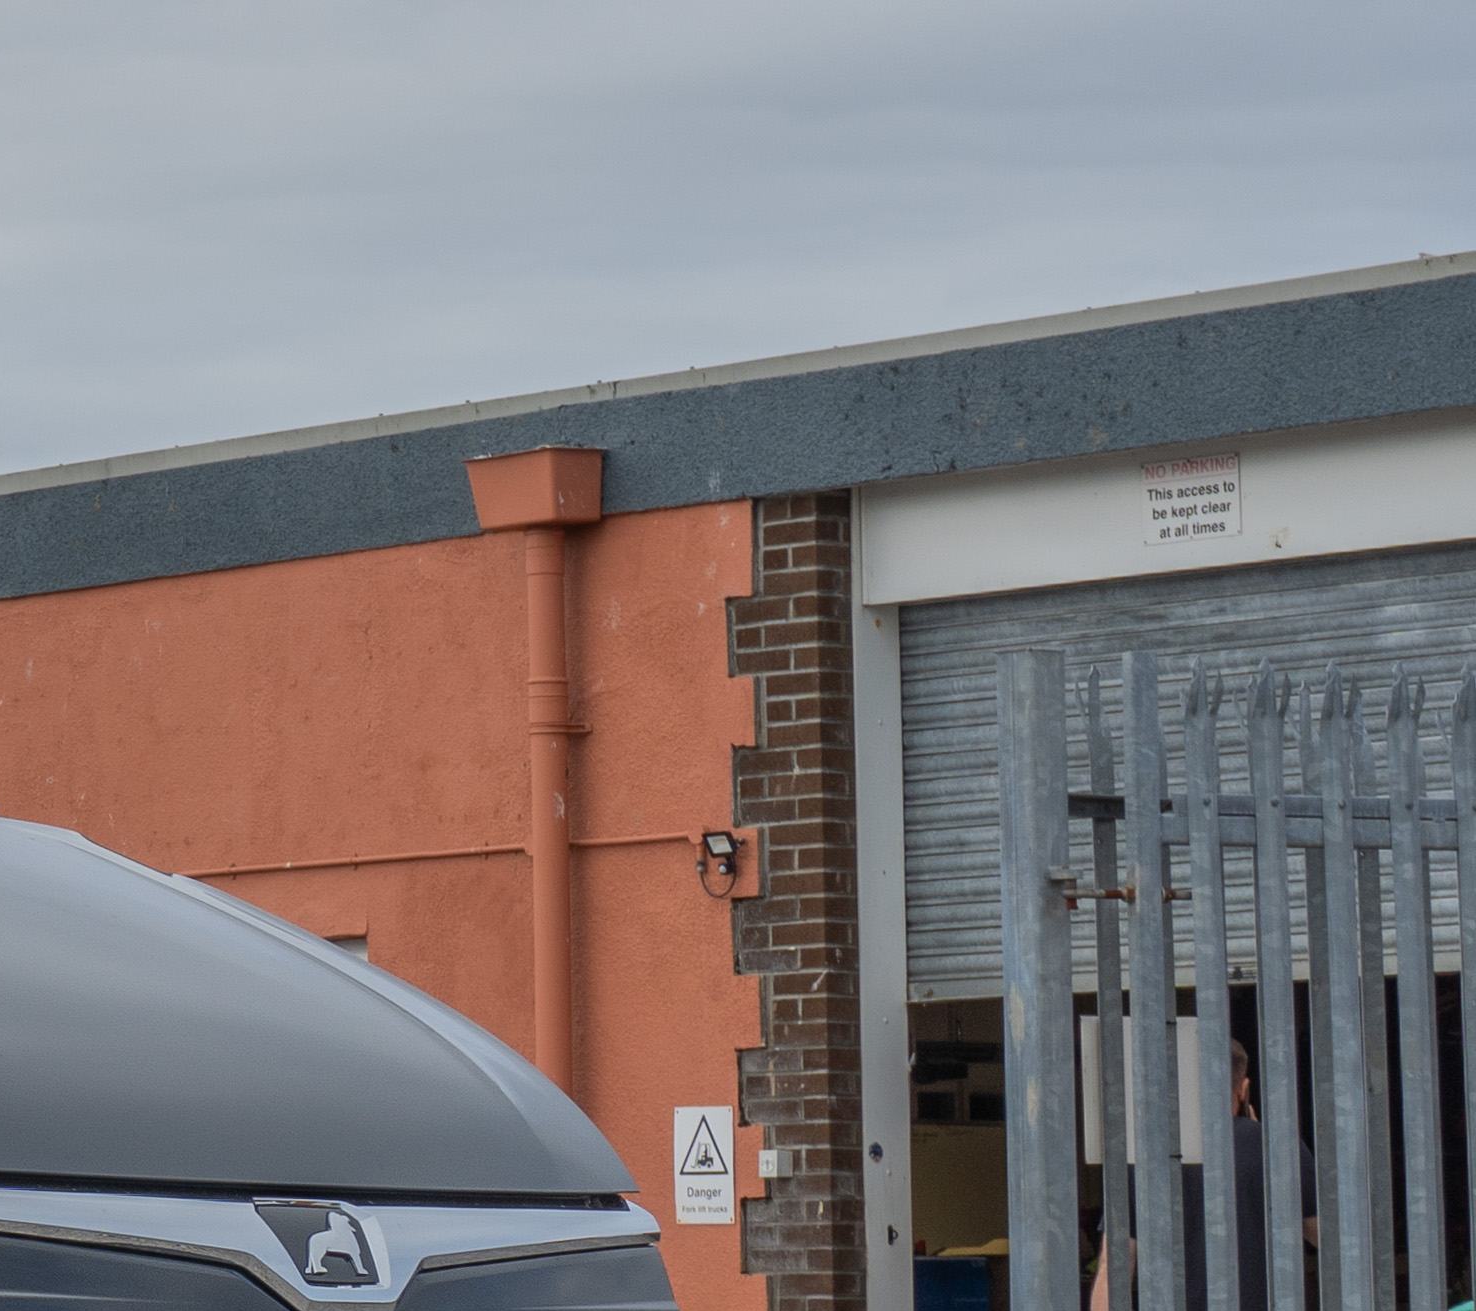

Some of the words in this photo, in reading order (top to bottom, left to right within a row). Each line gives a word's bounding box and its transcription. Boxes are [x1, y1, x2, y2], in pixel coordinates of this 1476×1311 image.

[1144, 464, 1166, 479] NO
[1171, 454, 1237, 476] PARKING
[1147, 487, 1173, 501] This
[1177, 483, 1220, 498] access
[1223, 480, 1235, 493] to
[1152, 508, 1167, 520] be
[1171, 504, 1198, 519] kept
[1201, 501, 1231, 514] clear
[1159, 526, 1171, 539] at
[1174, 523, 1188, 537] all
[1192, 521, 1226, 535] times
[686, 1187, 722, 1200] Danger
[707, 1205, 728, 1213] trucks
